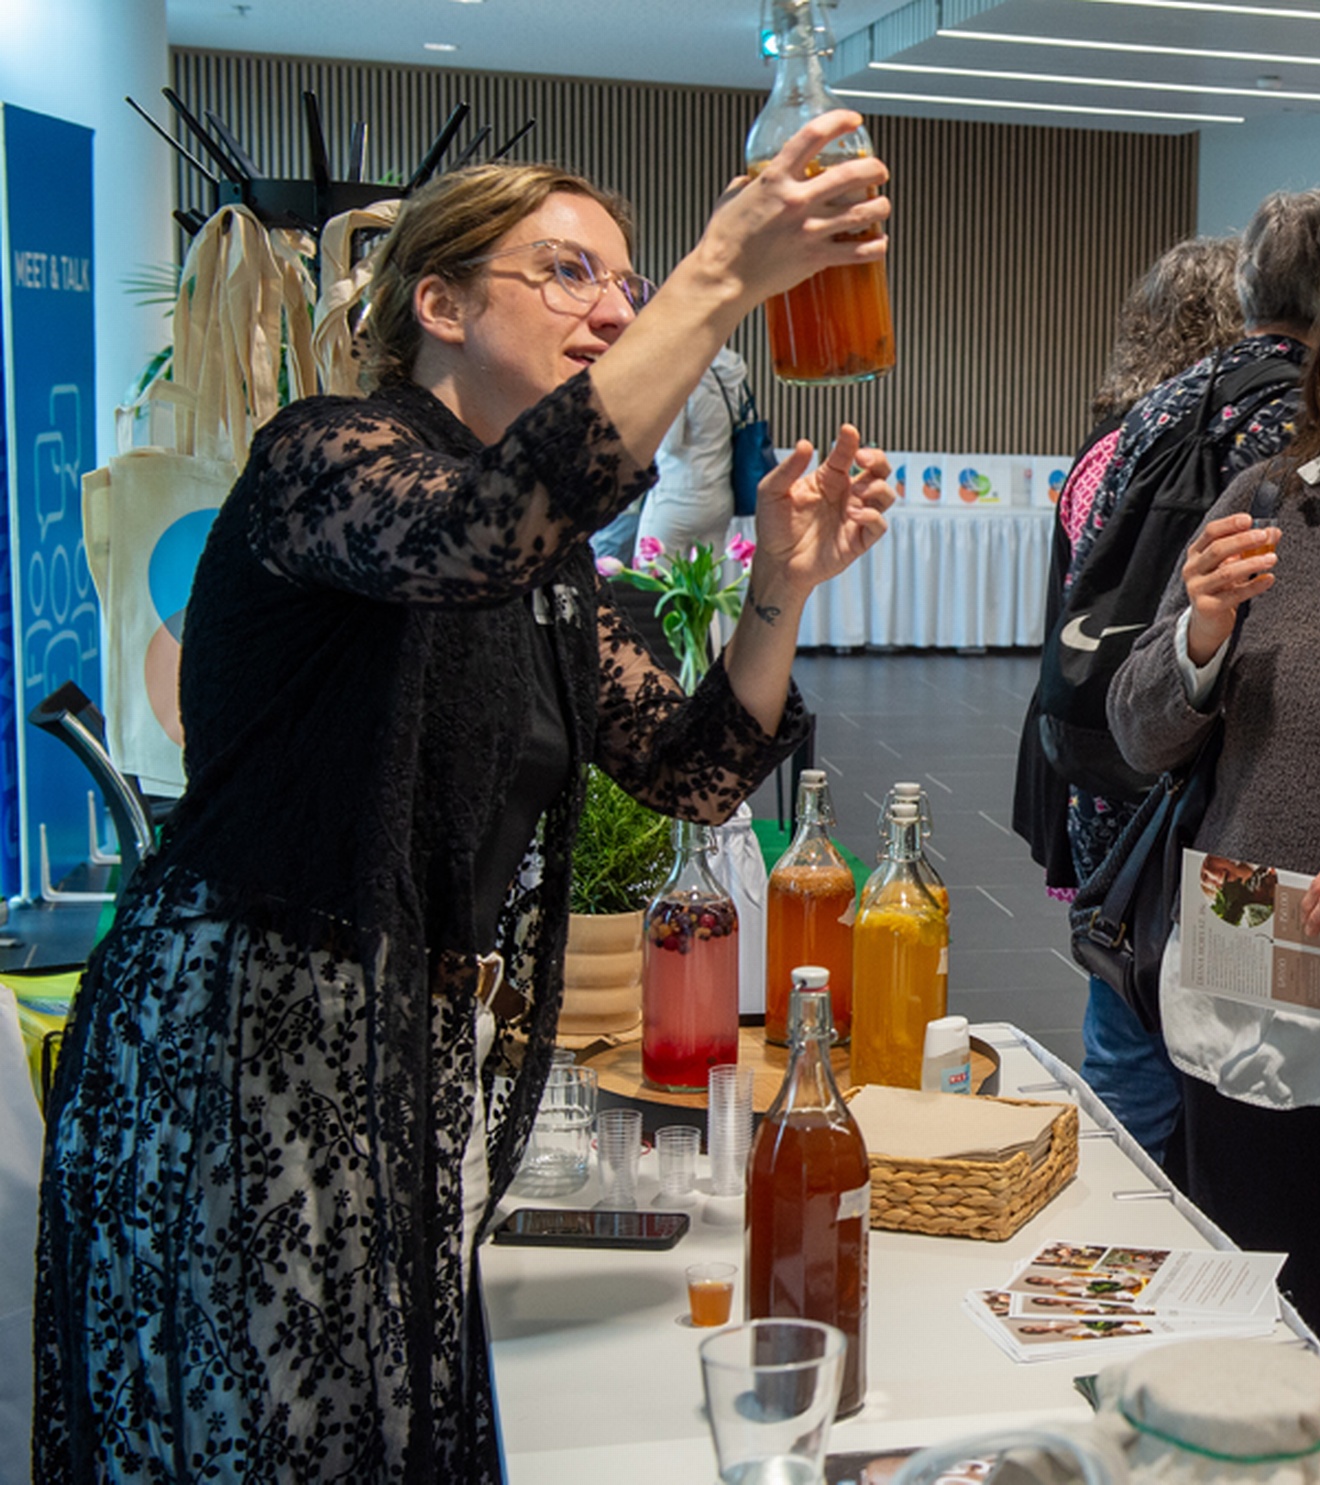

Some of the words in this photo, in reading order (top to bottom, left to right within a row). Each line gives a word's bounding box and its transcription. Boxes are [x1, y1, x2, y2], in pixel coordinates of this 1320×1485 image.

[14, 250, 48, 289] MEET
[50, 254, 60, 290] &
[61, 255, 91, 292] TALK
